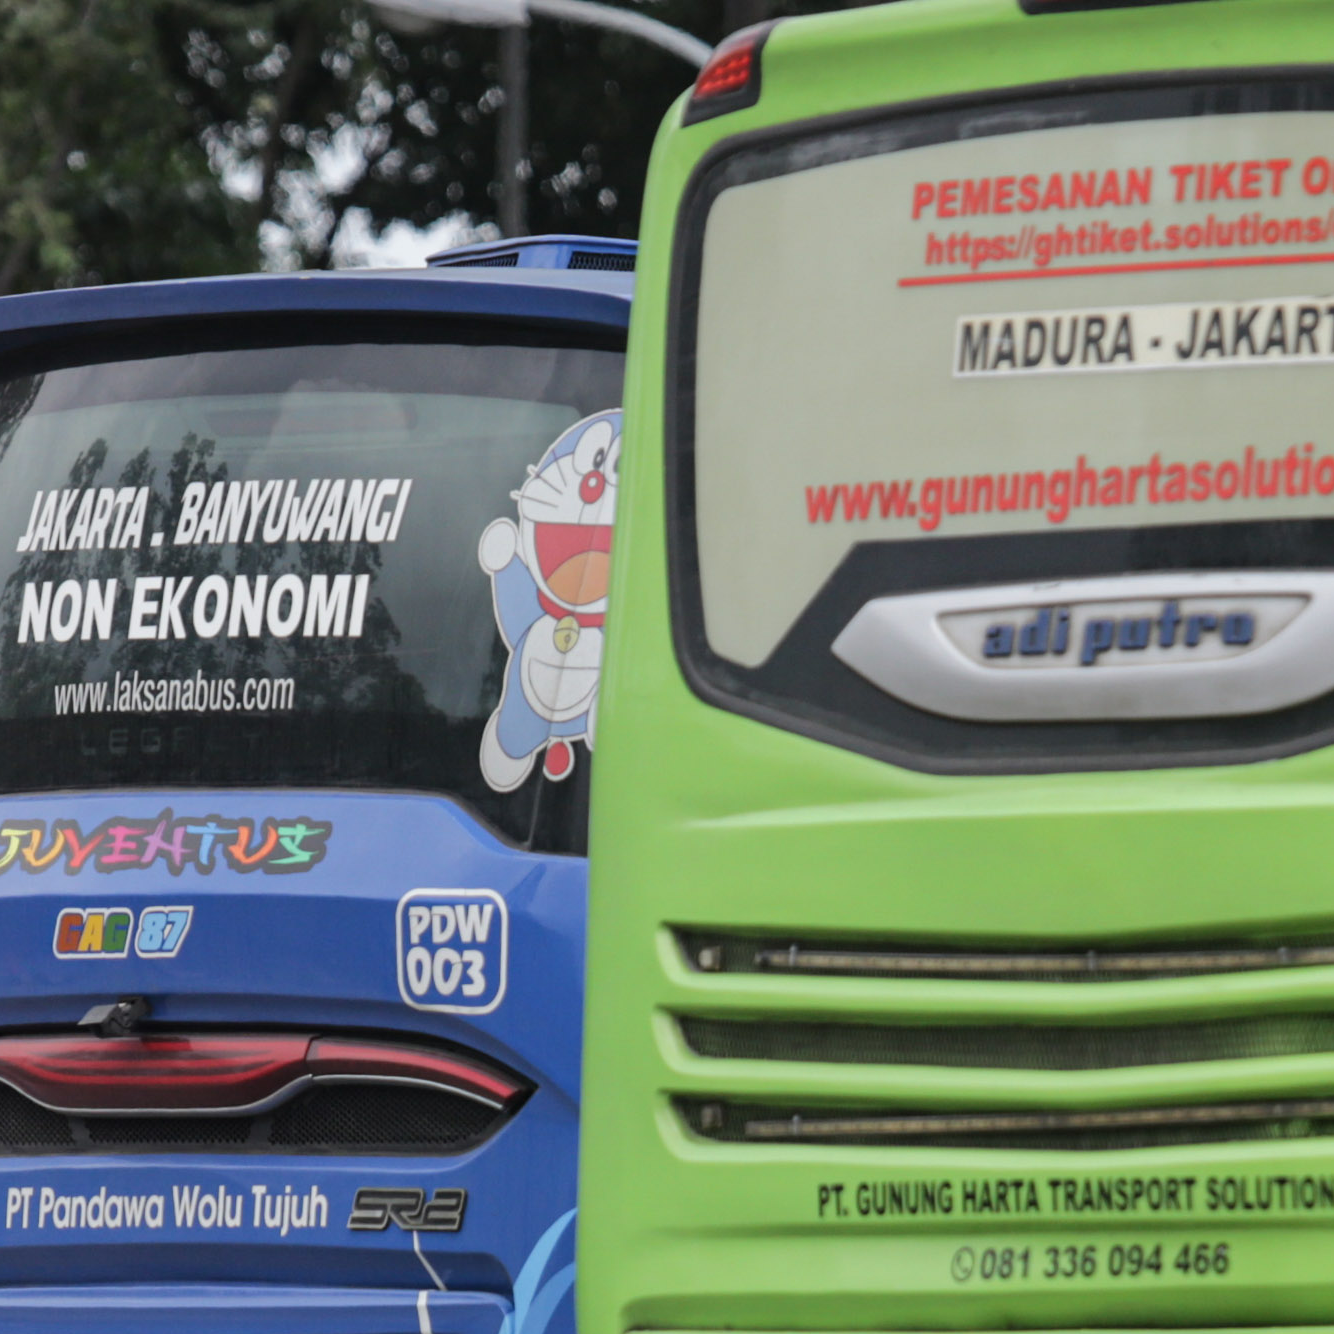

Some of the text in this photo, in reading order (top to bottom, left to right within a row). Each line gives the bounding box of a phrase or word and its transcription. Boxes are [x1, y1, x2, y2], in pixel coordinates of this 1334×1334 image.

[912, 165, 1152, 220] PEMESANAN
[1169, 158, 1288, 205] TIKET
[957, 312, 1136, 373] MADURA
[17, 485, 149, 553] JAKARTA
[173, 478, 413, 547] BANYUWANGI
[17, 574, 370, 643] NON EKONOMI
[983, 603, 1069, 659] adi
[54, 669, 295, 716] www.laksanabus.com
[137, 907, 192, 955] 87
[409, 904, 493, 945] PDW
[405, 947, 485, 996] 003
[6, 1184, 328, 1237] PT Pandawa Wolu Tujuh
[817, 1183, 849, 1219] PT.
[856, 1181, 954, 1217] GUNUNG
[962, 1179, 1040, 1215] HARTA
[1047, 1177, 1196, 1213] TRANSPORT
[979, 1243, 1231, 1280] 081 336 094 466
